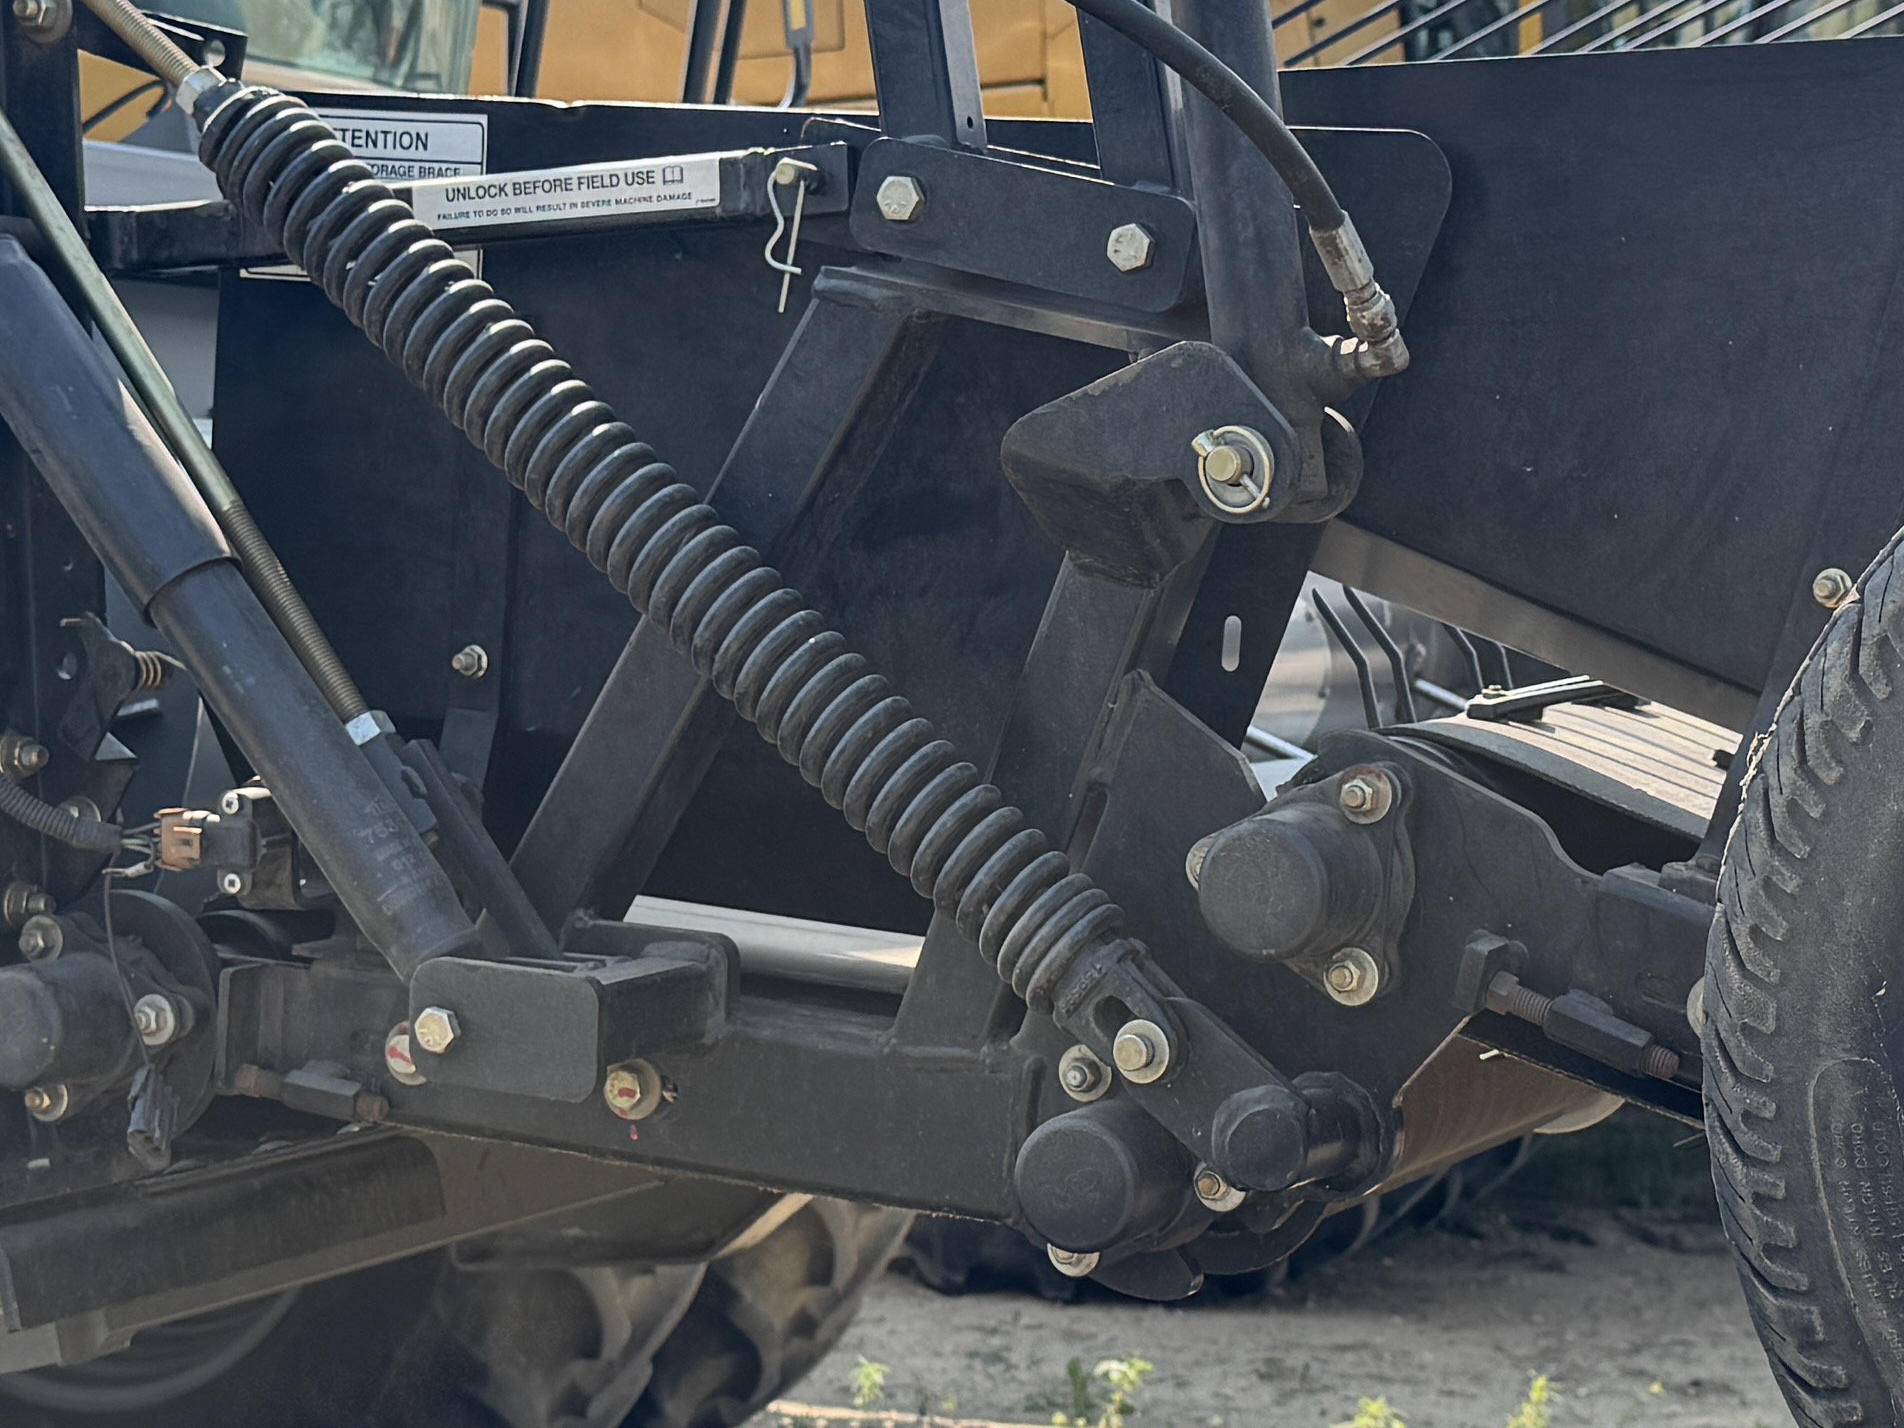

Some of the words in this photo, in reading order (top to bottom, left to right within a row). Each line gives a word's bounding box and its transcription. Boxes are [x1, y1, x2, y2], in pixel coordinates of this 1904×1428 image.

[333, 128, 429, 151] TENTION
[445, 182, 509, 203] UNLOCK
[512, 176, 574, 197] BEFORE
[577, 173, 620, 191] FIELD
[624, 169, 656, 187] USE
[437, 210, 471, 221] FAILURE
[473, 209, 484, 218] TO
[486, 208, 498, 217] DO
[501, 207, 512, 216] SO
[514, 204, 533, 214] WILL
[536, 202, 567, 213] RESULT
[569, 202, 578, 210] IN
[581, 198, 612, 209] SEVERE
[615, 195, 653, 206] MACHINE
[656, 192, 692, 203] DAMAGE
